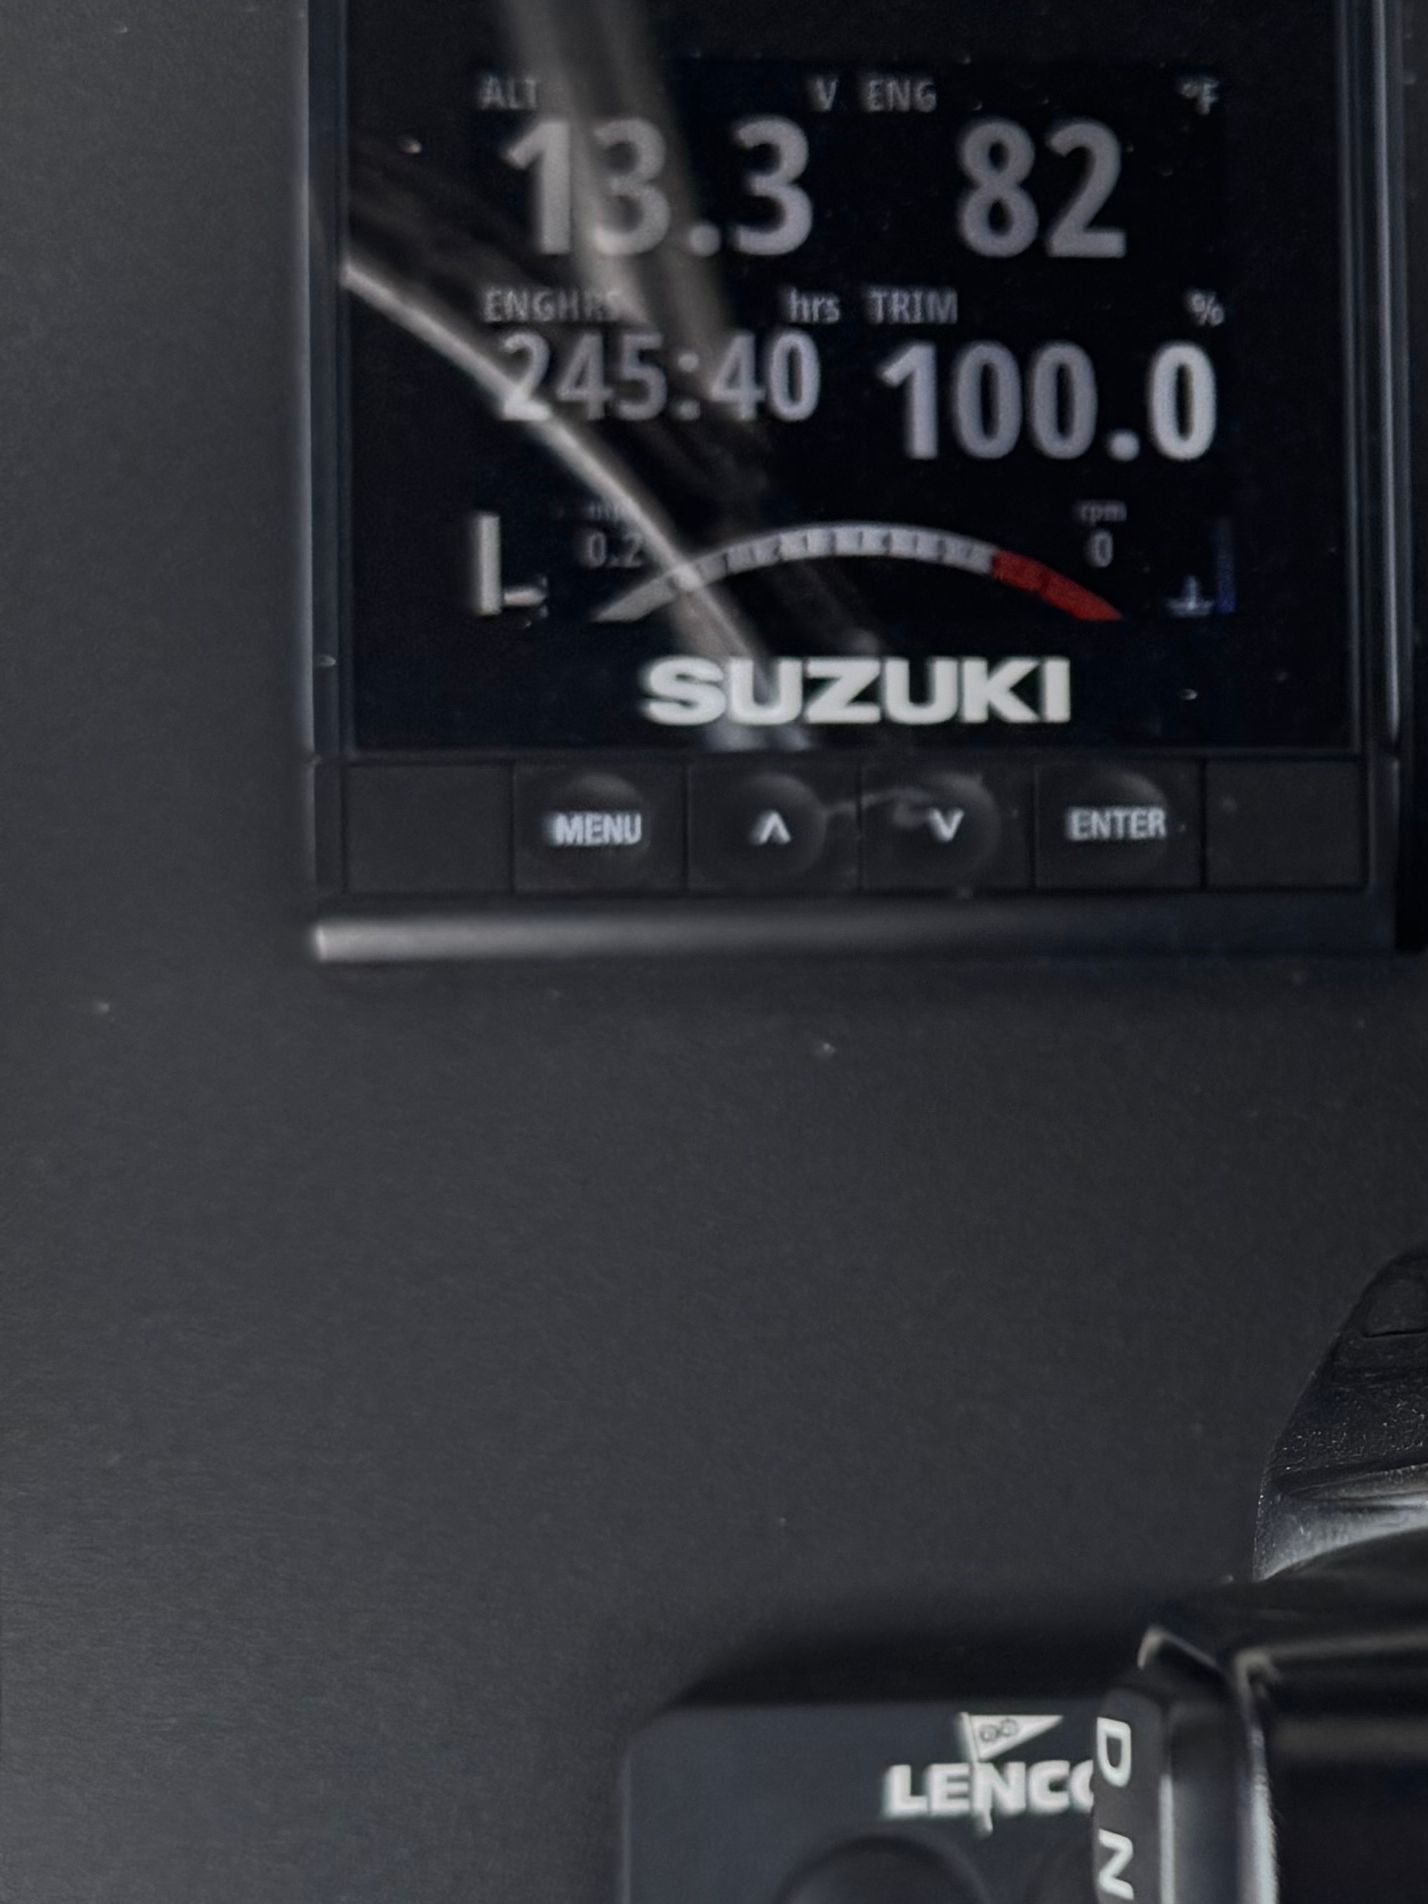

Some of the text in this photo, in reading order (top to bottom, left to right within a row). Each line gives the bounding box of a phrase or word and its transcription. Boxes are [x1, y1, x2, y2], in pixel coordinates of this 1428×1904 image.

[480, 76, 540, 111] ALT
[813, 77, 838, 112] V
[866, 76, 938, 113] ENG
[505, 117, 815, 256] 13.3
[957, 120, 1128, 259] 82
[787, 288, 841, 324] hrs
[866, 290, 958, 325] TRIM
[1188, 289, 1224, 328] %
[500, 330, 820, 422] 245:40
[880, 341, 1217, 460] 100.0
[1076, 500, 1127, 525] rpm
[1089, 529, 1113, 568] 0
[642, 656, 1071, 724] SUZUKI
[552, 811, 643, 846] MENU
[1068, 806, 1168, 841] ENTER
